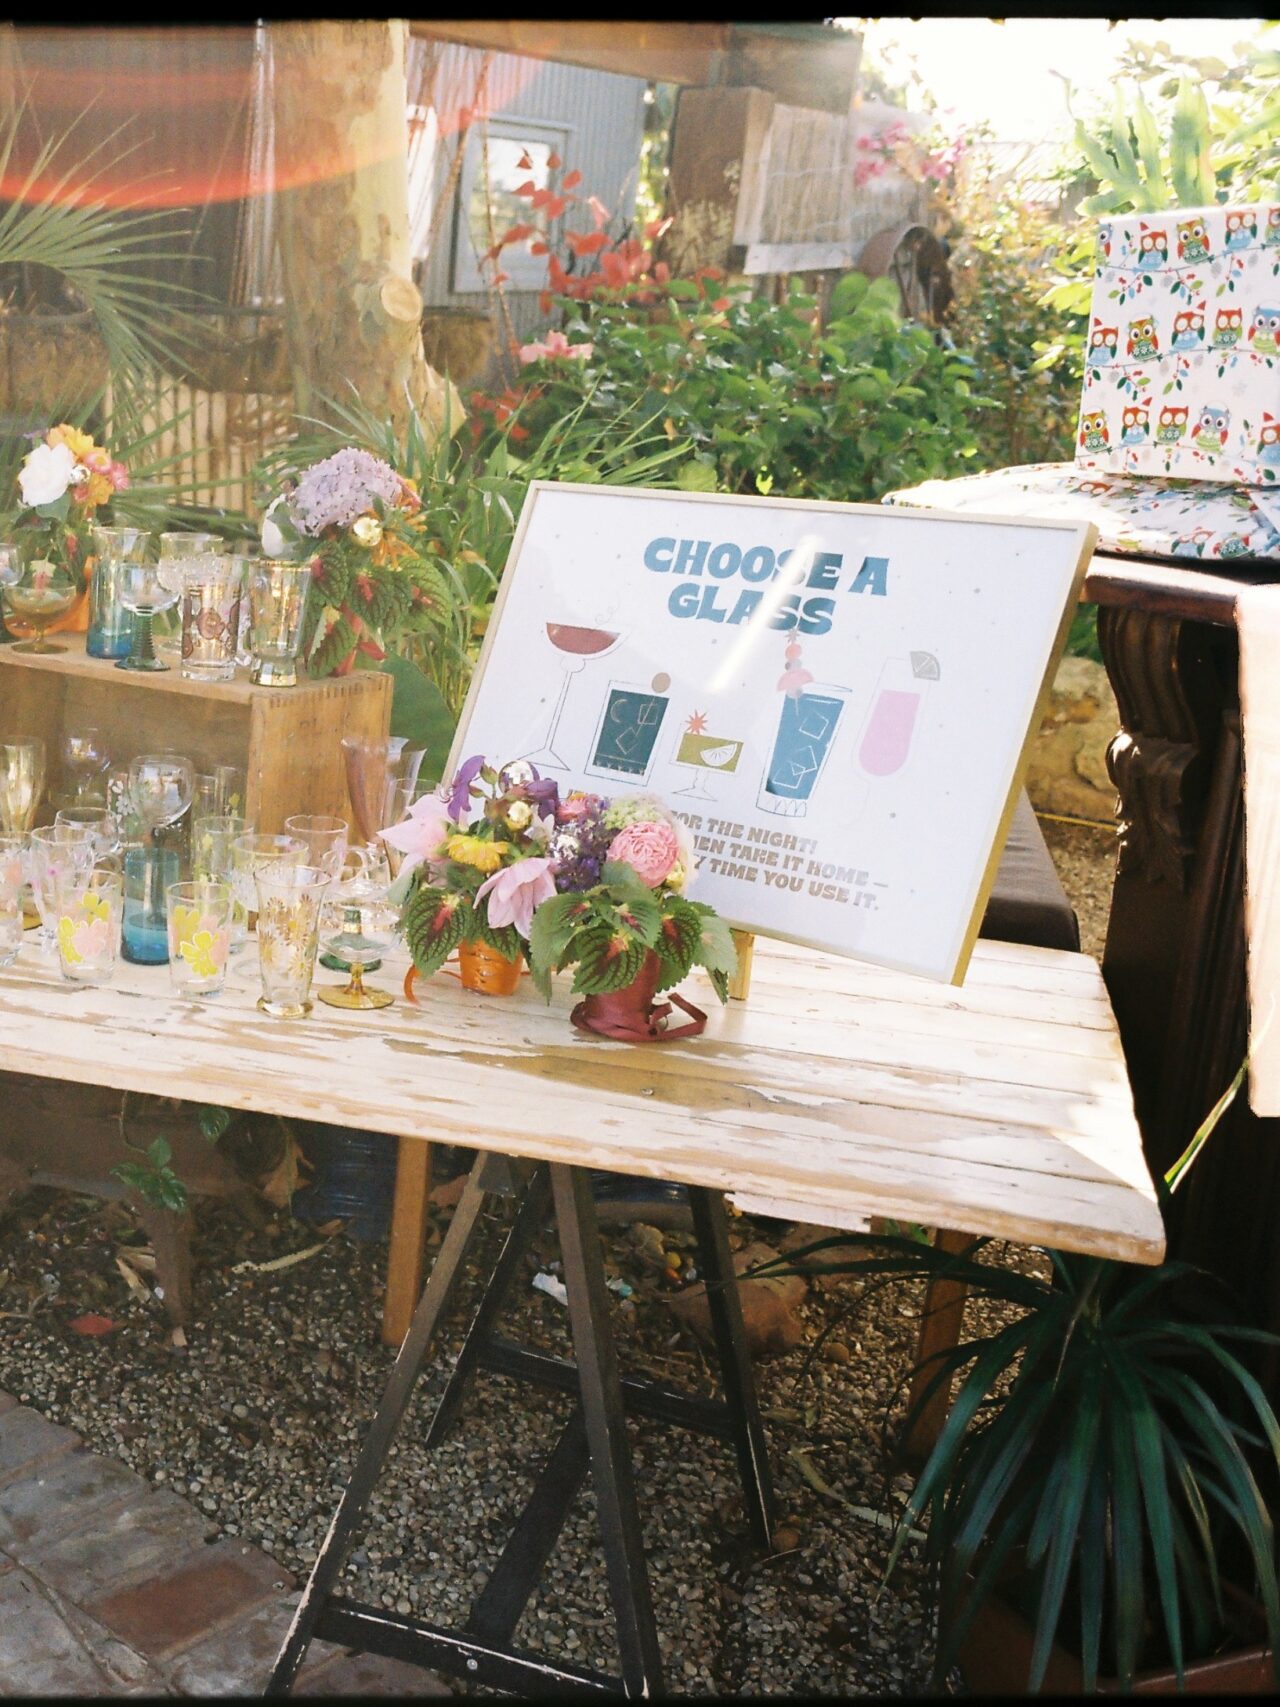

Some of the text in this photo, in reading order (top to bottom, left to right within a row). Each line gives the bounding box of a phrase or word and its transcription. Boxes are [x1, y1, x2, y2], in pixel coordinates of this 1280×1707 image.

[848, 556, 890, 596] A
[668, 582, 837, 636] GLASS
[671, 810, 818, 854] OR THE NIGHT!
[709, 858, 758, 882] TIME
[764, 870, 804, 893] YOU
[808, 881, 850, 904] USE
[853, 891, 880, 911] IT.
[729, 842, 779, 867] TAKE
[782, 855, 804, 871] IT
[806, 860, 869, 887] HOME
